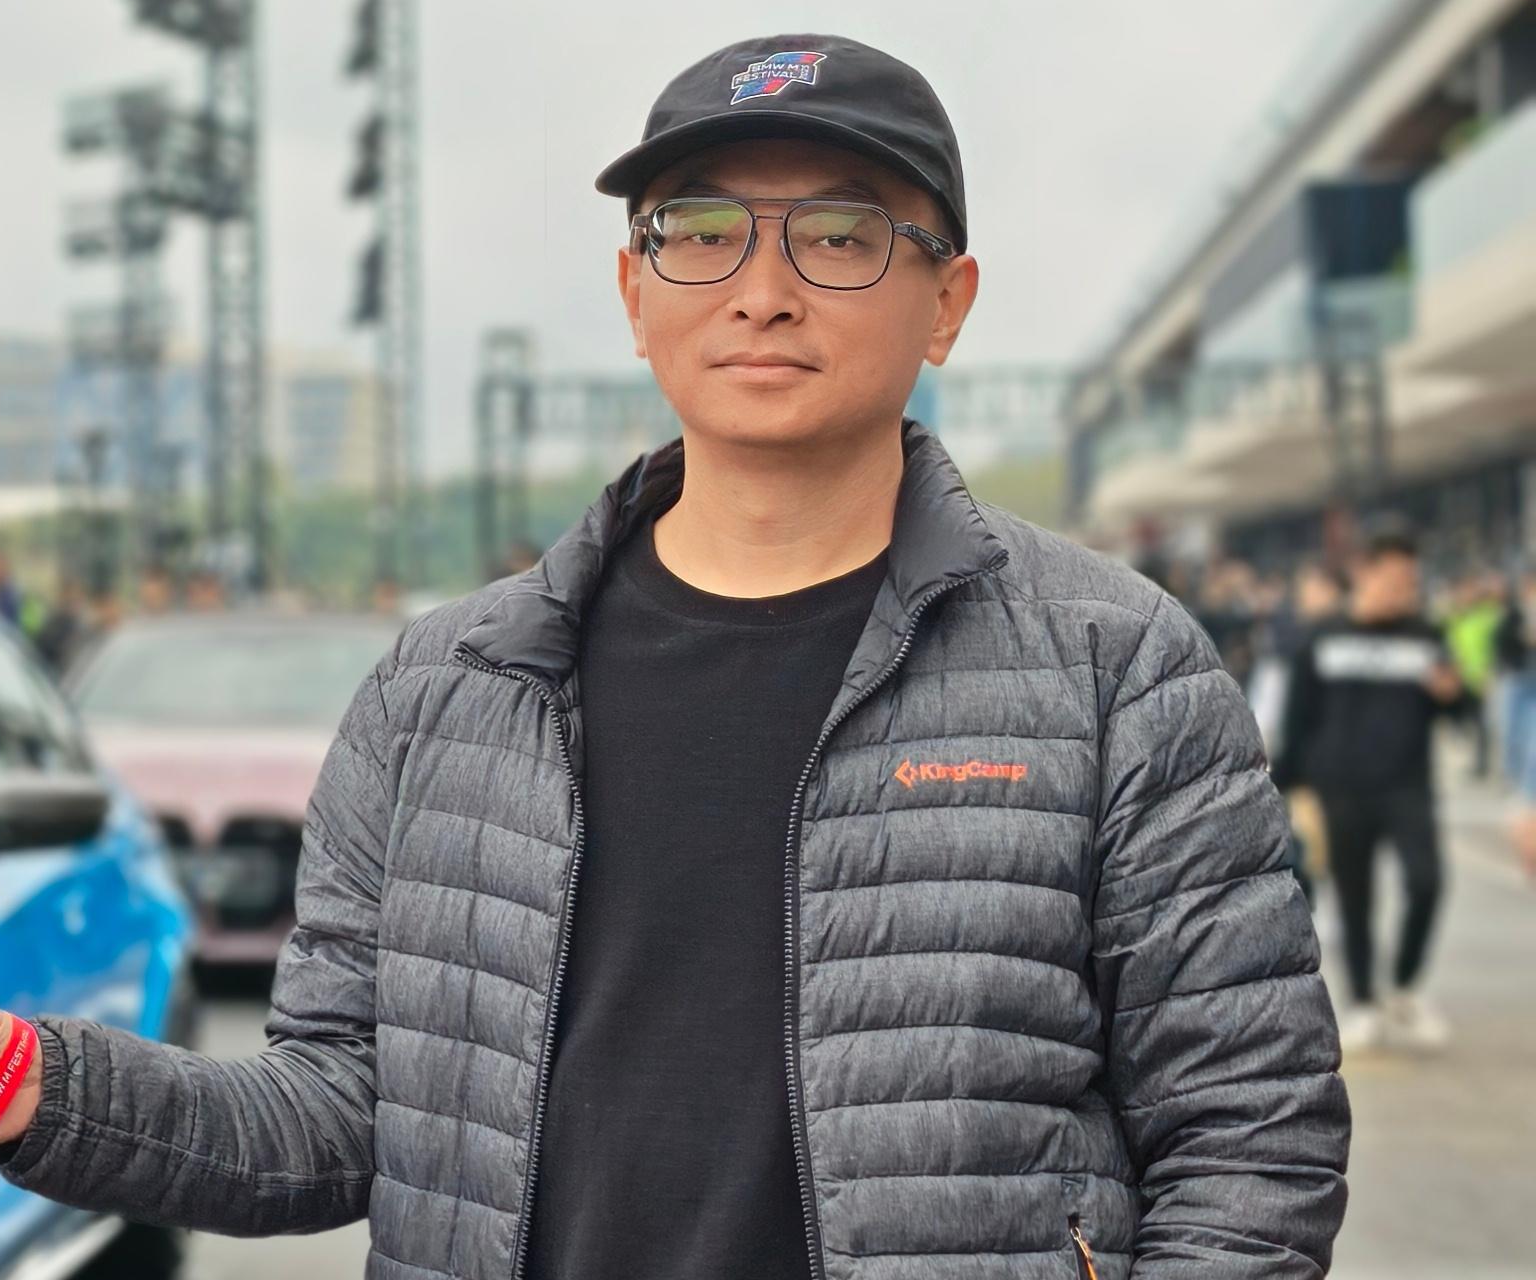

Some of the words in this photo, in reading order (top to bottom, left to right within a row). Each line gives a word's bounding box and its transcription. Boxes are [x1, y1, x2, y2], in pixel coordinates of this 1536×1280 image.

[751, 63, 783, 72] BMW
[787, 63, 799, 72] M
[735, 70, 797, 85] FESTIVAL
[919, 761, 1027, 782] KingCamp
[2, 1072, 12, 1084] M
